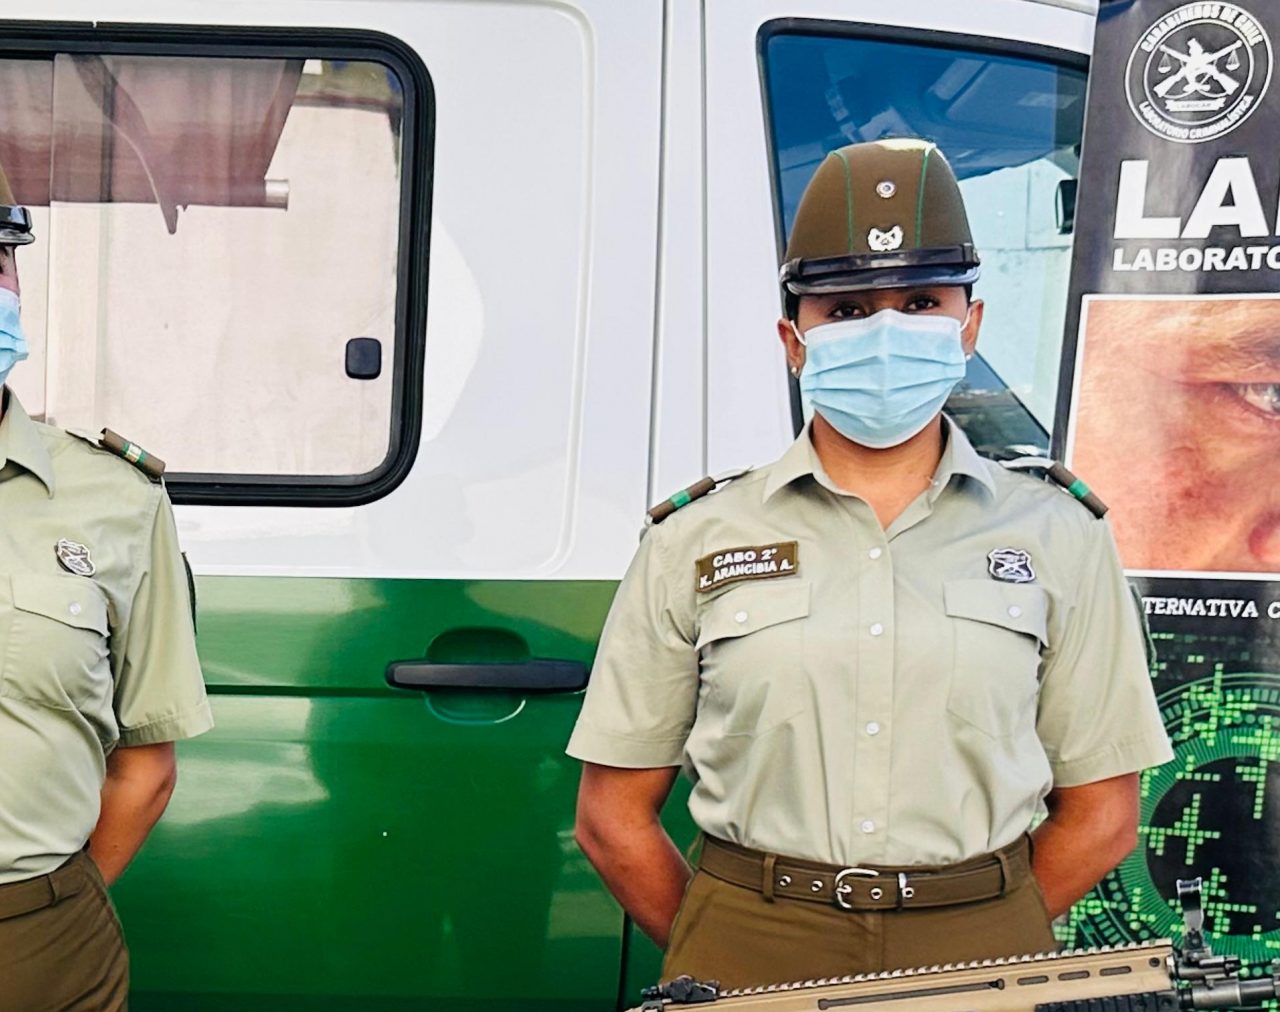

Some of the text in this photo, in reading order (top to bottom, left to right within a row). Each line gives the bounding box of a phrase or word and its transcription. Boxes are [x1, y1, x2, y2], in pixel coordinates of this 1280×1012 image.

[1113, 157, 1280, 239] LA
[713, 550, 757, 568] CABO
[713, 561, 778, 583] ARANCIBIA
